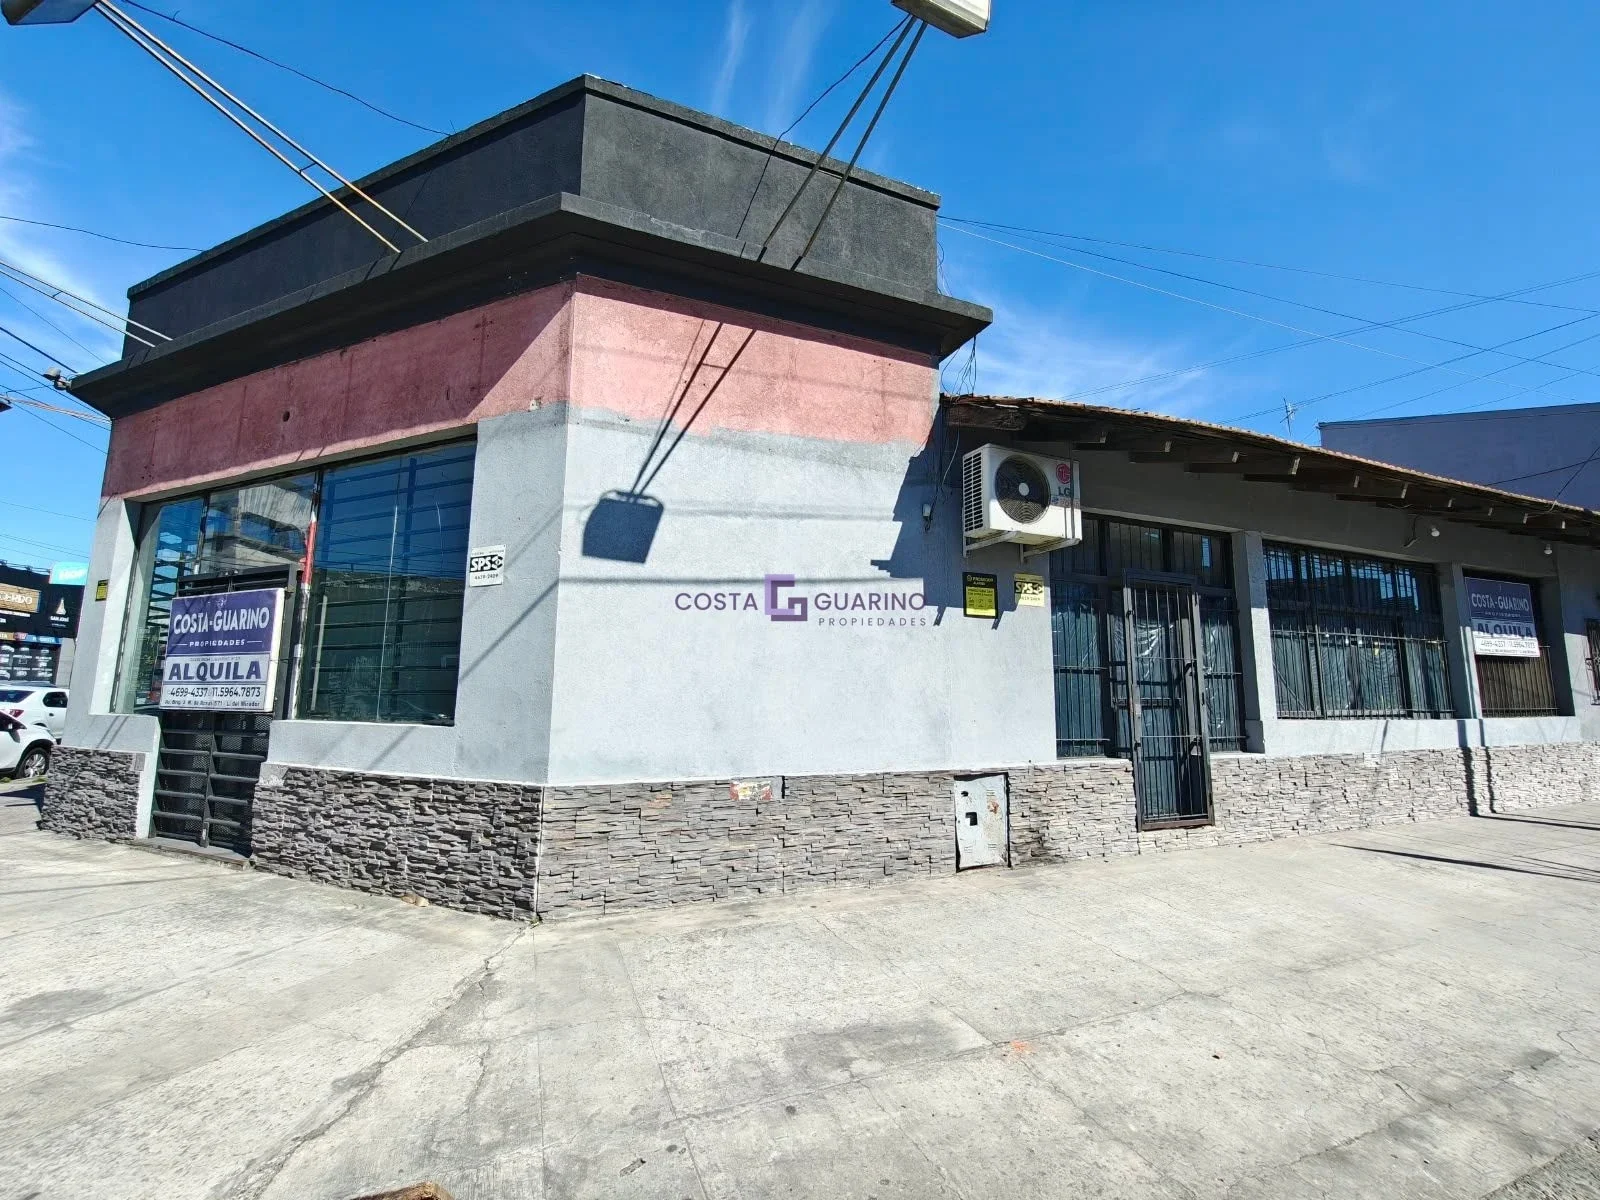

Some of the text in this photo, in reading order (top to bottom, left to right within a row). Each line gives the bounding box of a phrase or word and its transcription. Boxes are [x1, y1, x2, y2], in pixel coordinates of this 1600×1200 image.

[471, 556, 491, 571] SPS
[1016, 582, 1033, 594] SPS
[1471, 593, 1530, 611] COSTA-GUARINO
[173, 607, 270, 634] COSTA-GUARINO
[1477, 623, 1533, 638] ALQUILA
[189, 639, 246, 647] PROPIEDADES
[168, 661, 262, 681] ALQUILA
[170, 686, 261, 697] 4699-4337 11.5964.7873
